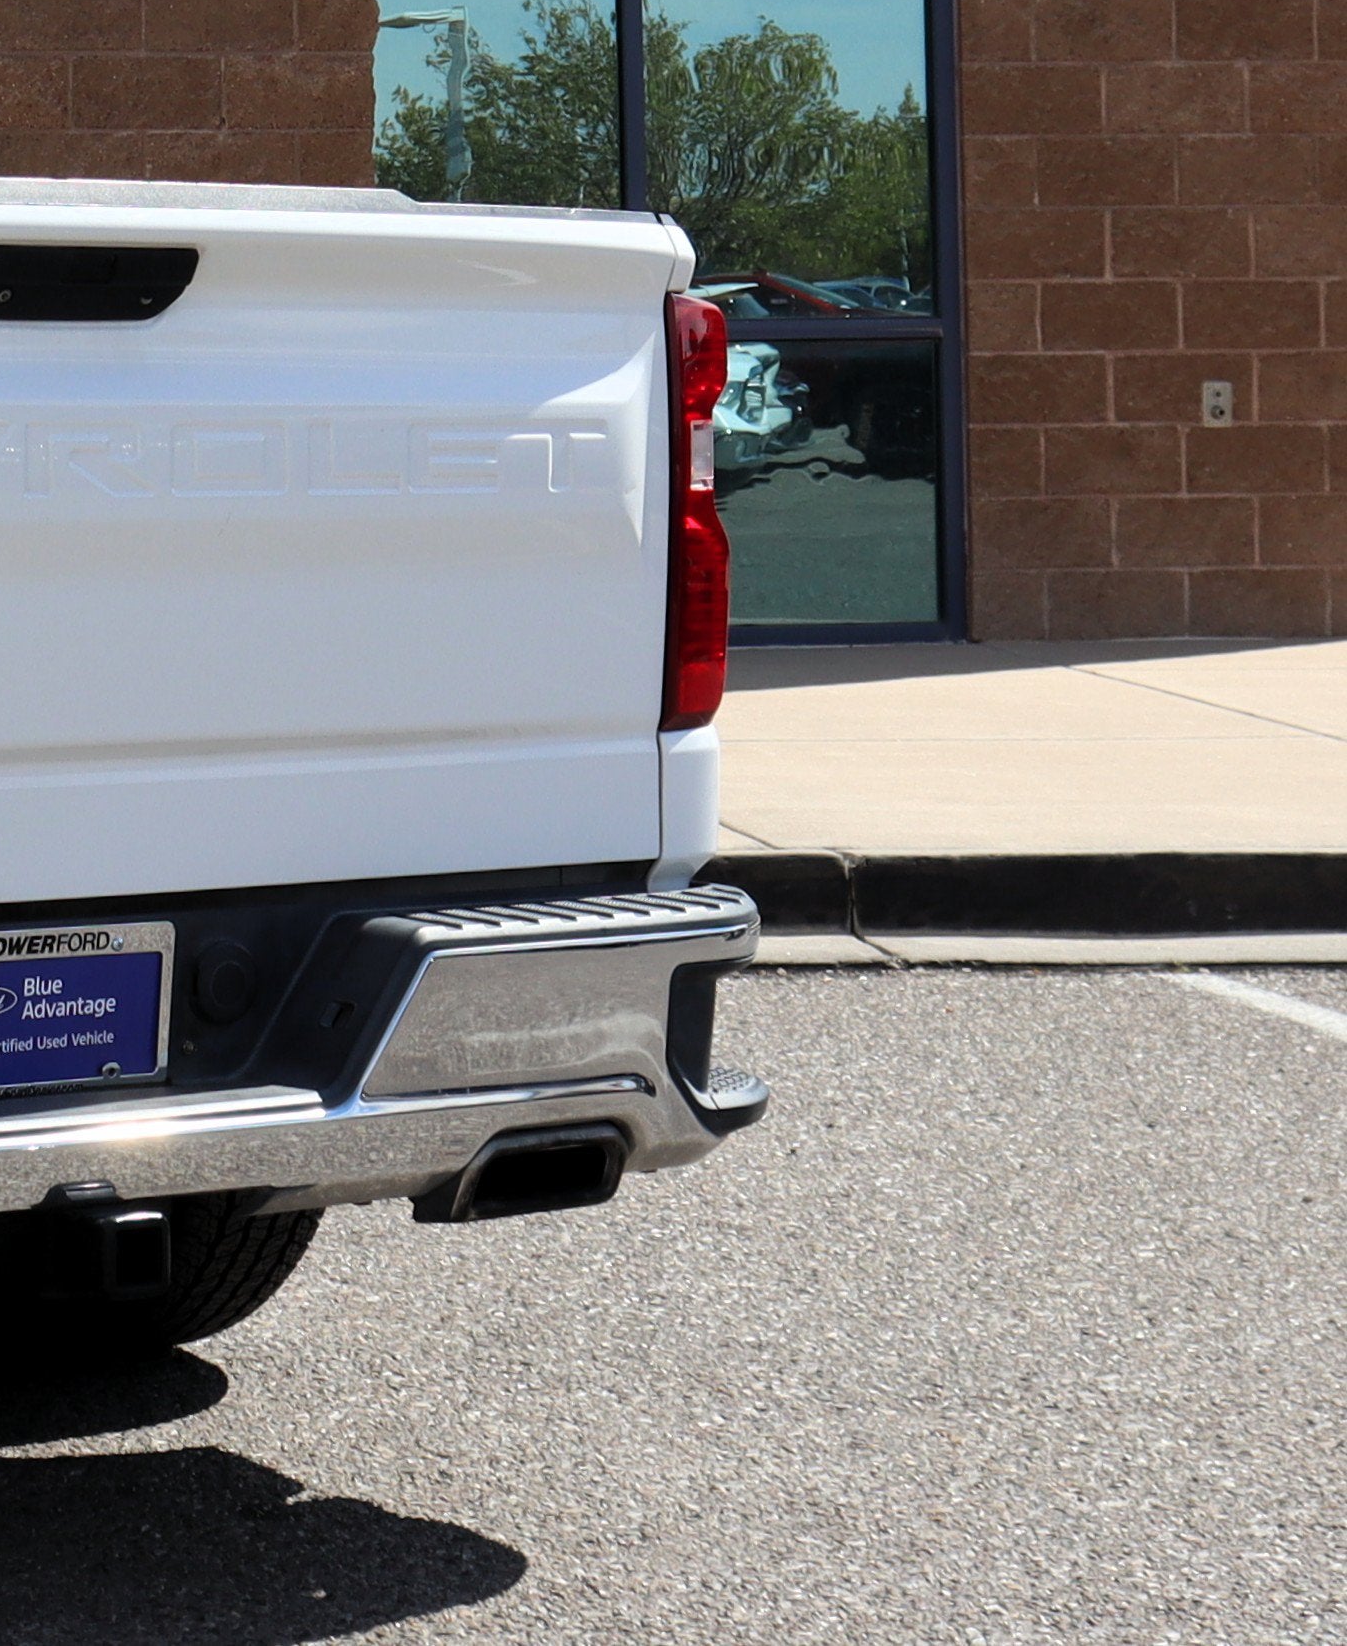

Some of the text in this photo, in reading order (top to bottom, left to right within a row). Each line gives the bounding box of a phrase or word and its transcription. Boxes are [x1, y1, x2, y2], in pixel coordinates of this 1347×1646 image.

[23, 976, 63, 997] Blue
[21, 996, 117, 1020] Advantage
[37, 1034, 68, 1050] Used
[71, 1030, 115, 1046] Vehicle
